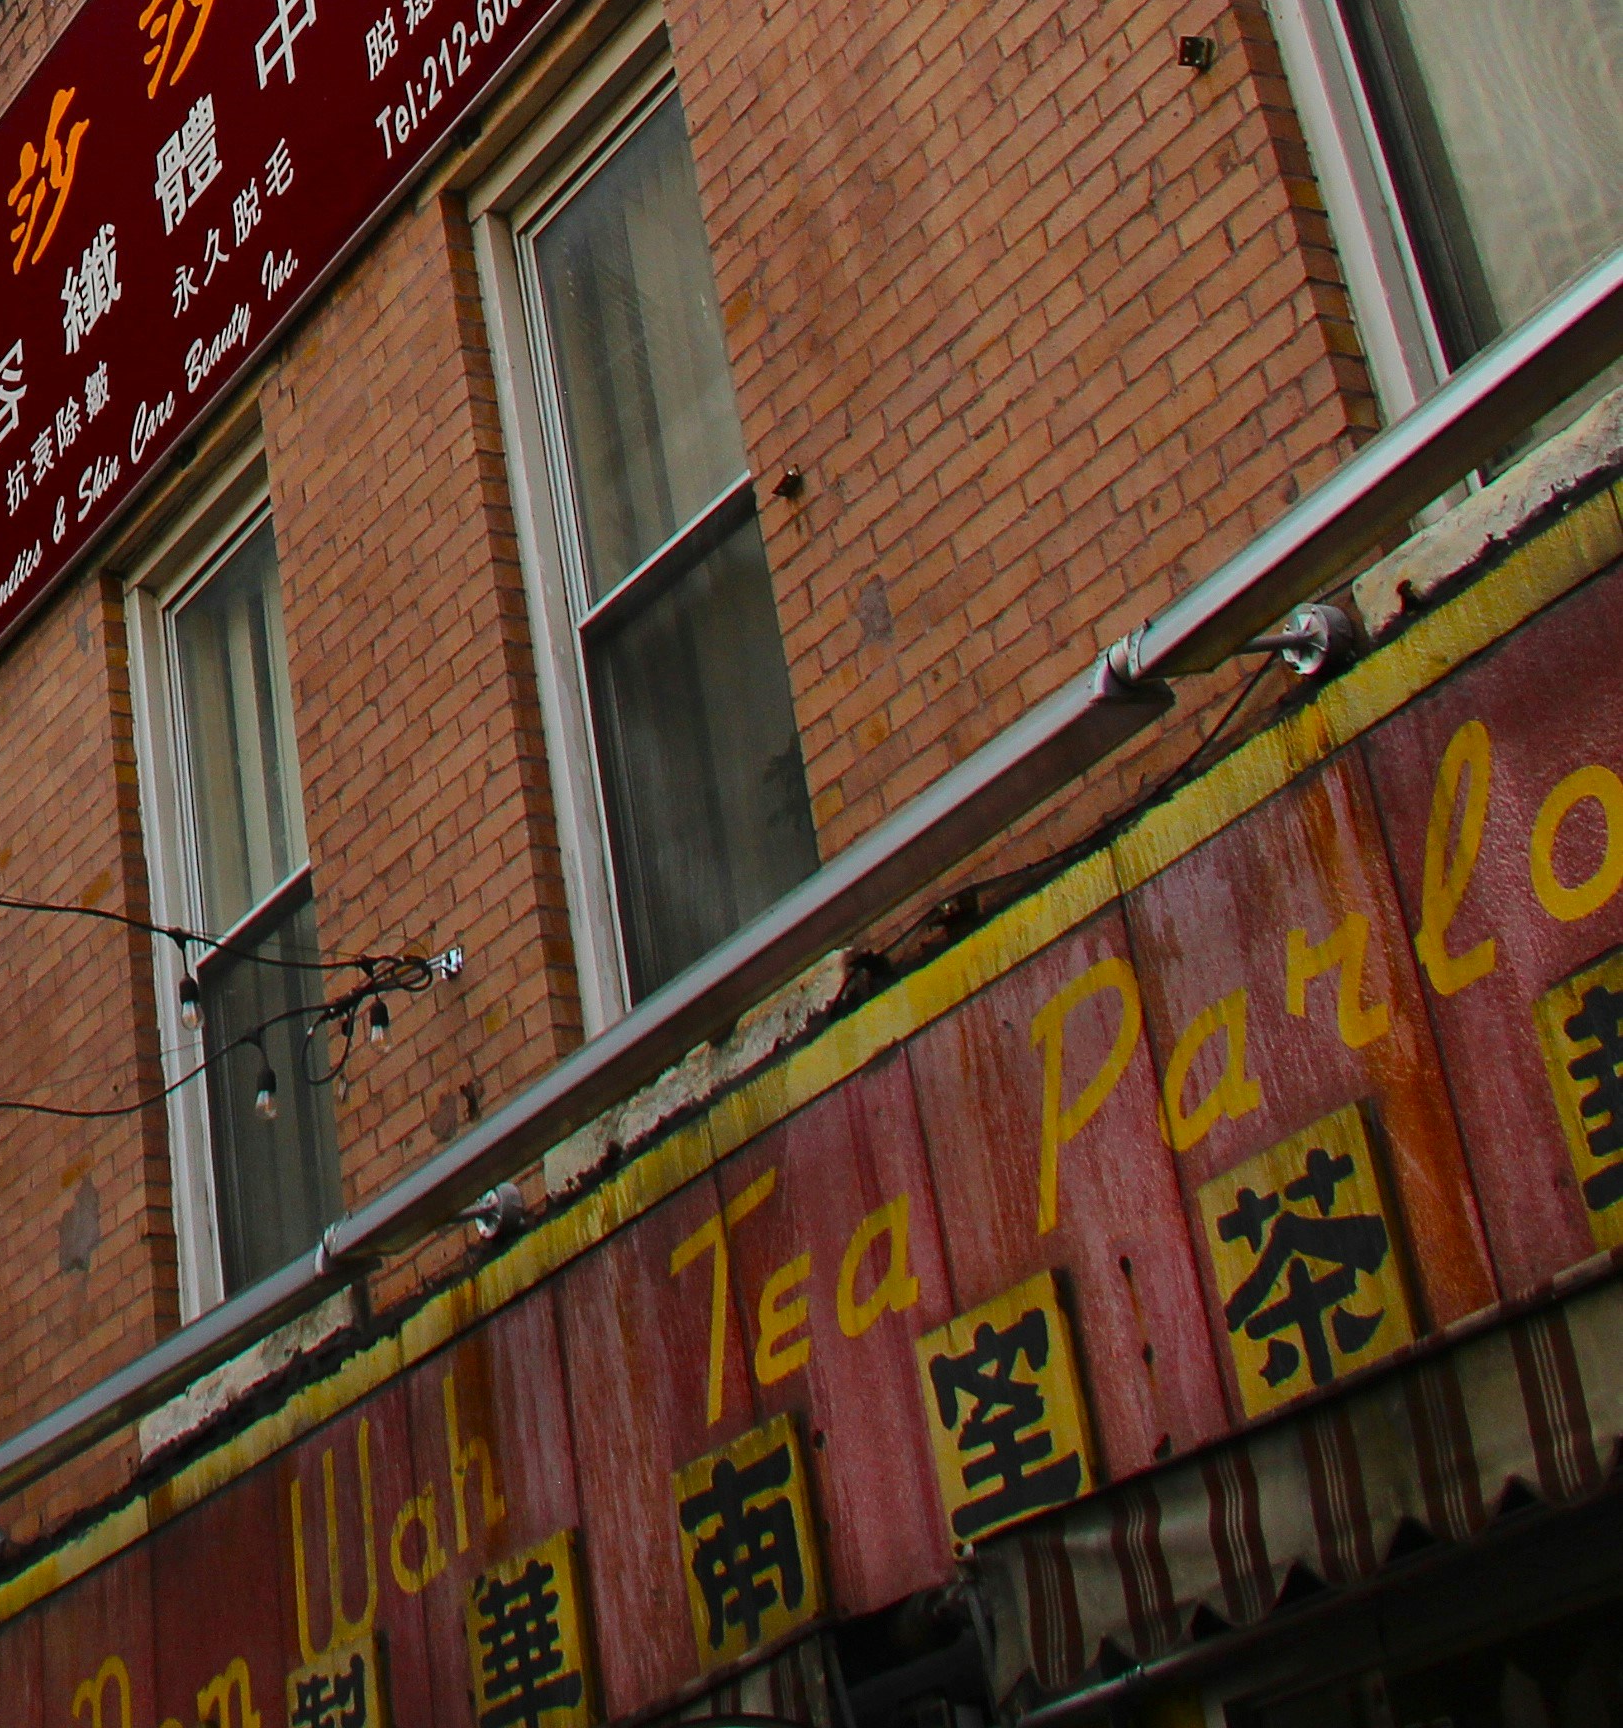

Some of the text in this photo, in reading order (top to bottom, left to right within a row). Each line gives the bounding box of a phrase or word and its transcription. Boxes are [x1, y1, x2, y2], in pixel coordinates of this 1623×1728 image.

[53, 496, 65, 543] &
[78, 456, 120, 522] Skin
[131, 391, 174, 463] Care
[185, 303, 251, 393] Beauty
[262, 249, 298, 300] Inc.
[291, 1375, 505, 1667] Wah
[672, 1169, 918, 1425] Tea
